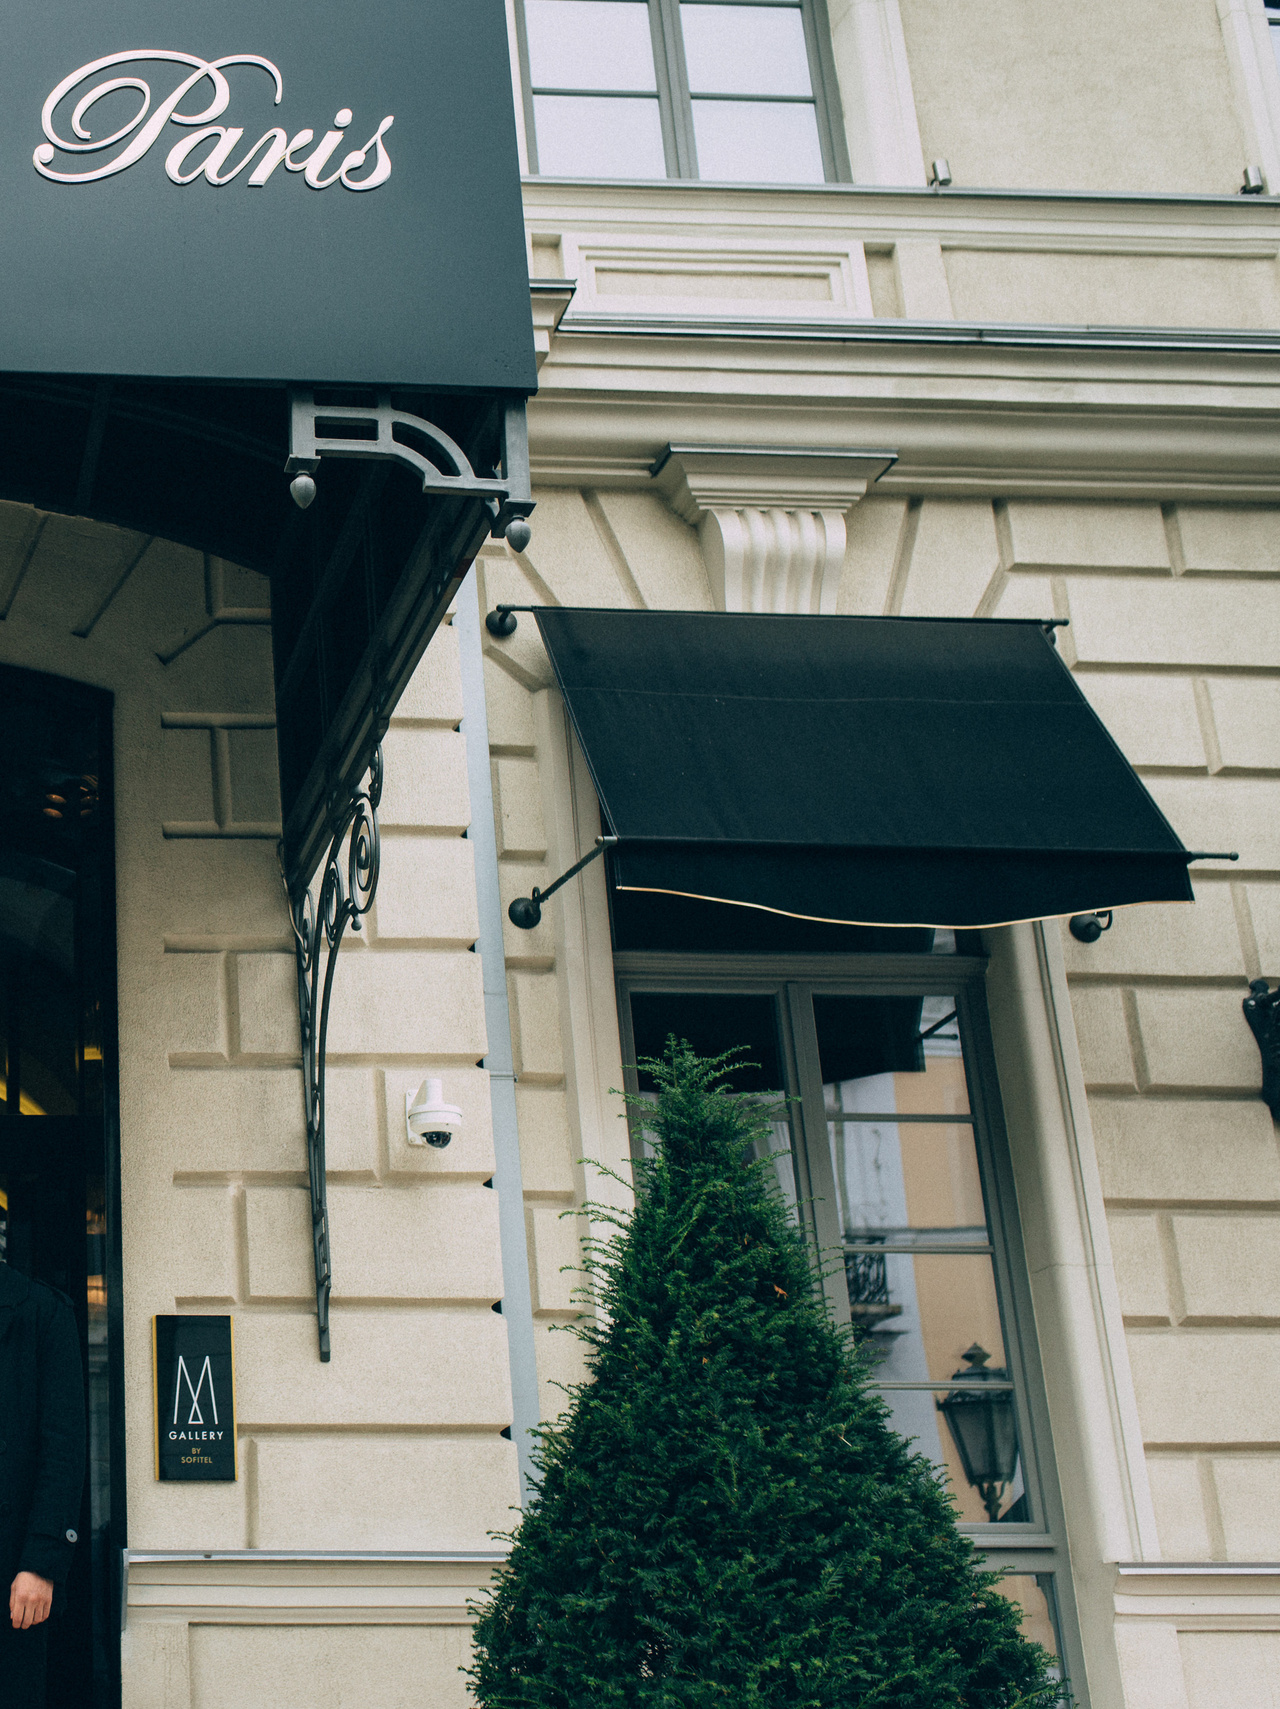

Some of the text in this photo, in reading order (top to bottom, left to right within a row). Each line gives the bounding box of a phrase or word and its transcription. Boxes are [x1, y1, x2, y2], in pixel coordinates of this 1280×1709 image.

[32, 48, 396, 191] Paris
[168, 1430, 224, 1441] GALLERY
[191, 1447, 202, 1455] BY
[180, 1456, 213, 1464] SOFITEL
